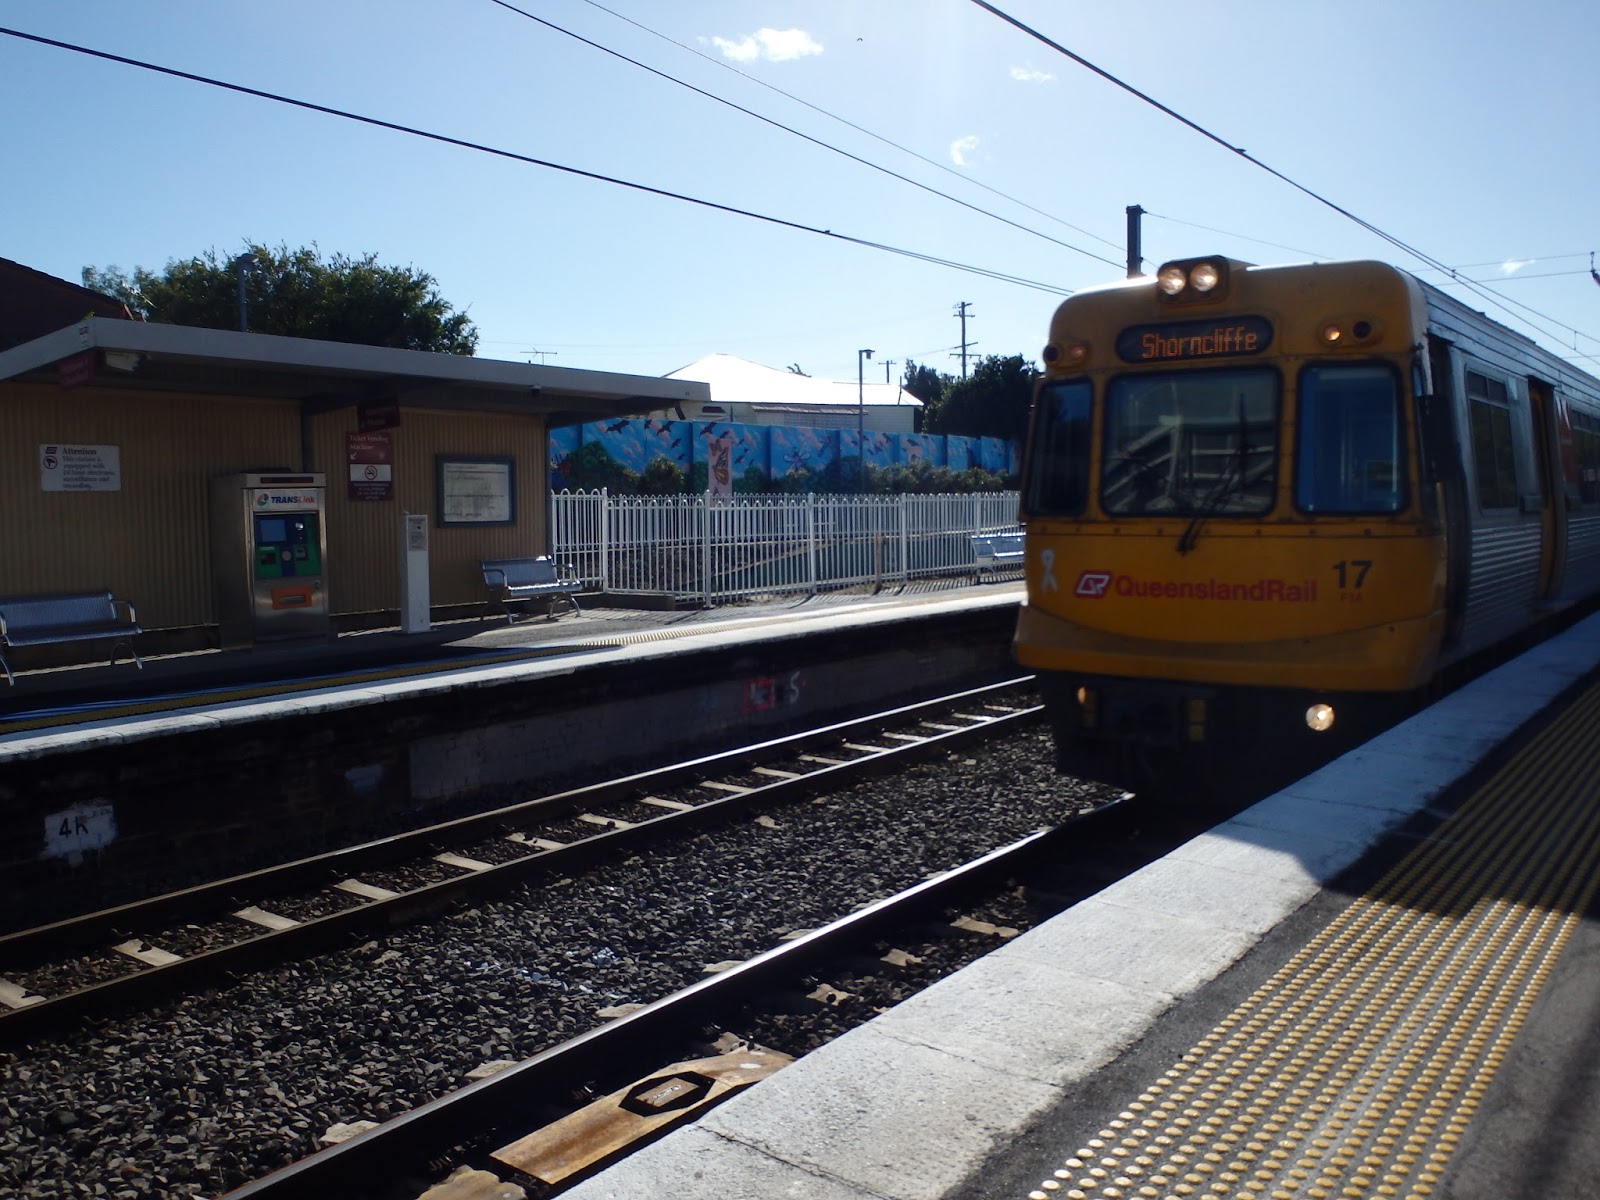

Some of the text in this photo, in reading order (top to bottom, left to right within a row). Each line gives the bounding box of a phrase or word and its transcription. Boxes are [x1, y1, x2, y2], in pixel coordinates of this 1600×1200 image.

[1141, 326, 1257, 359] Shorncliffe
[63, 447, 97, 455] Attention
[1332, 560, 1373, 588] 17
[1115, 575, 1318, 602] QueenslandRail
